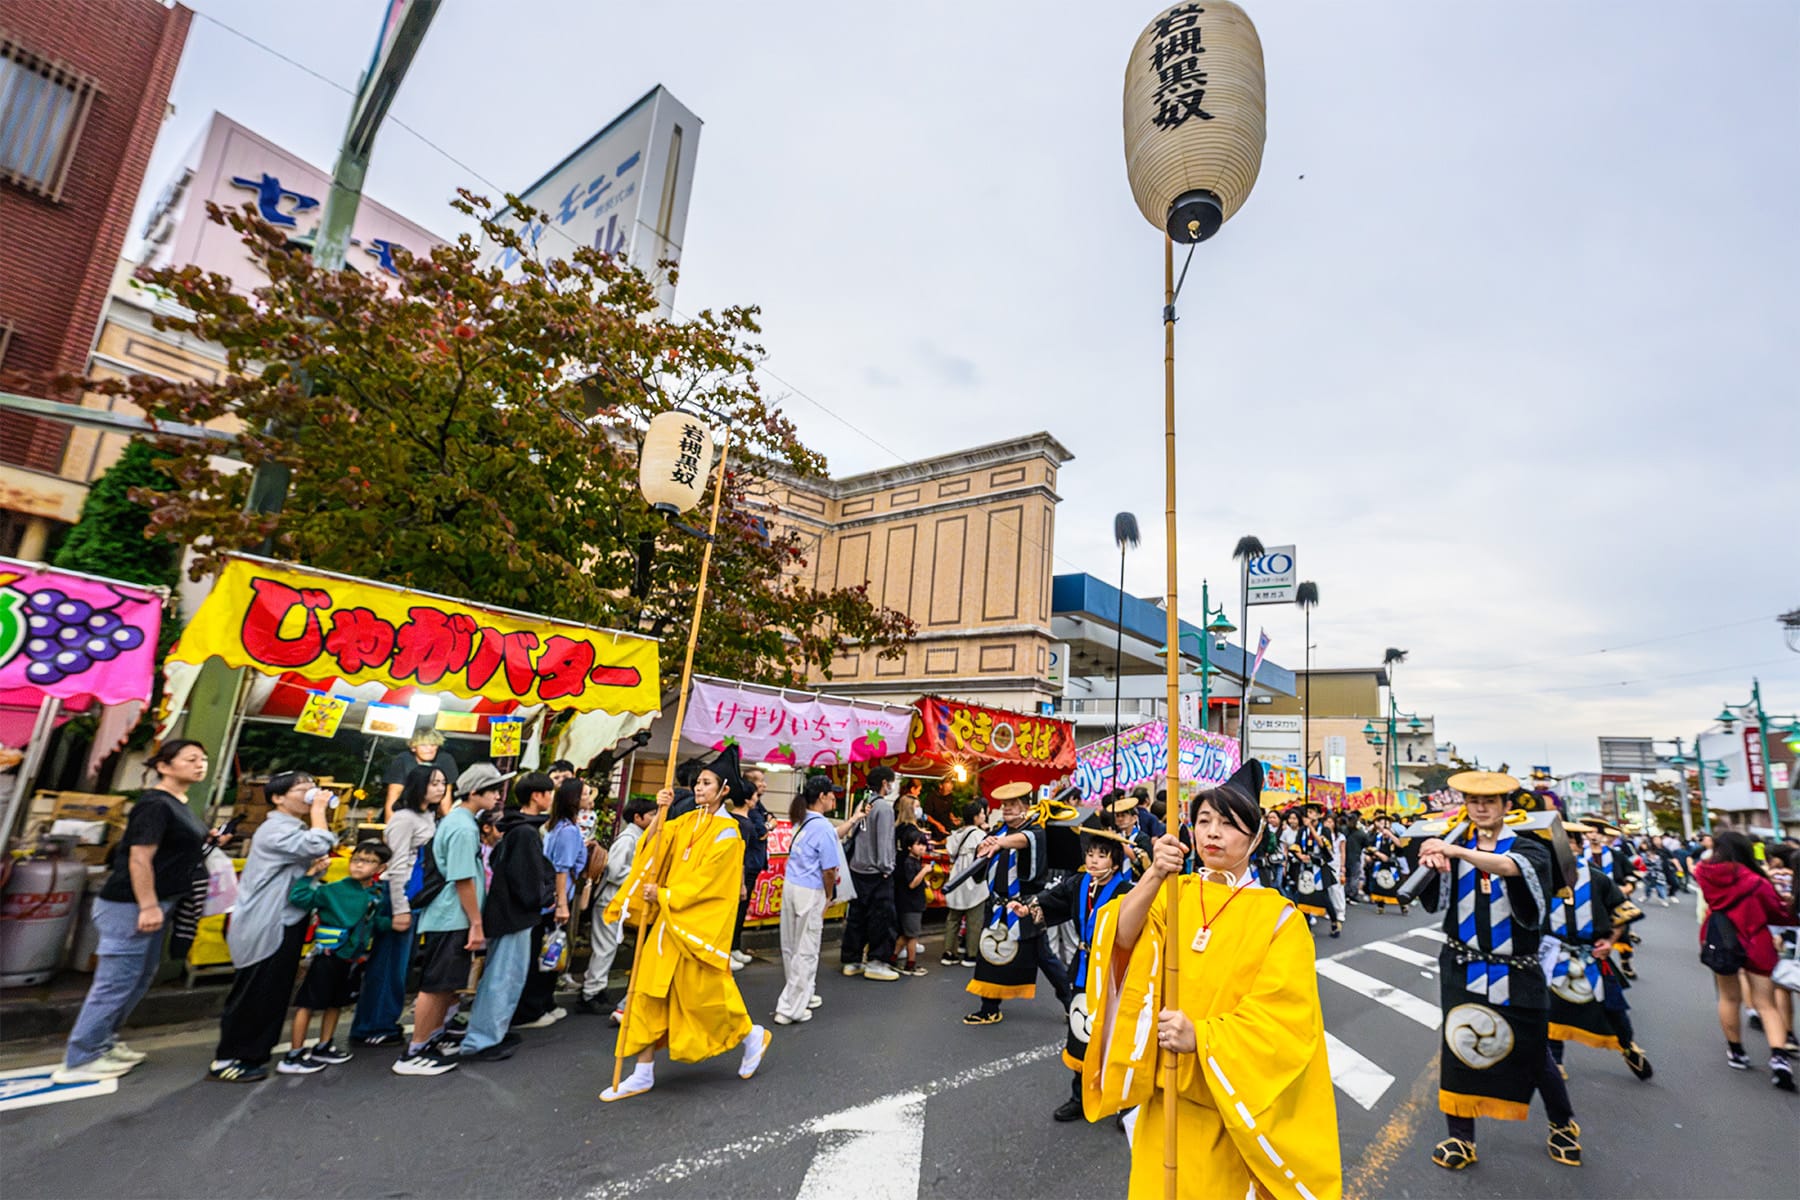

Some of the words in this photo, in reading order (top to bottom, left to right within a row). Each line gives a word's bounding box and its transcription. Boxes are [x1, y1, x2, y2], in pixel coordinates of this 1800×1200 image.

[1149, 3, 1216, 133] 岩槻黒奴
[669, 423, 705, 490] 岩槻黒奴
[241, 576, 642, 700] じゃがバター
[714, 701, 851, 743] けずりいちご
